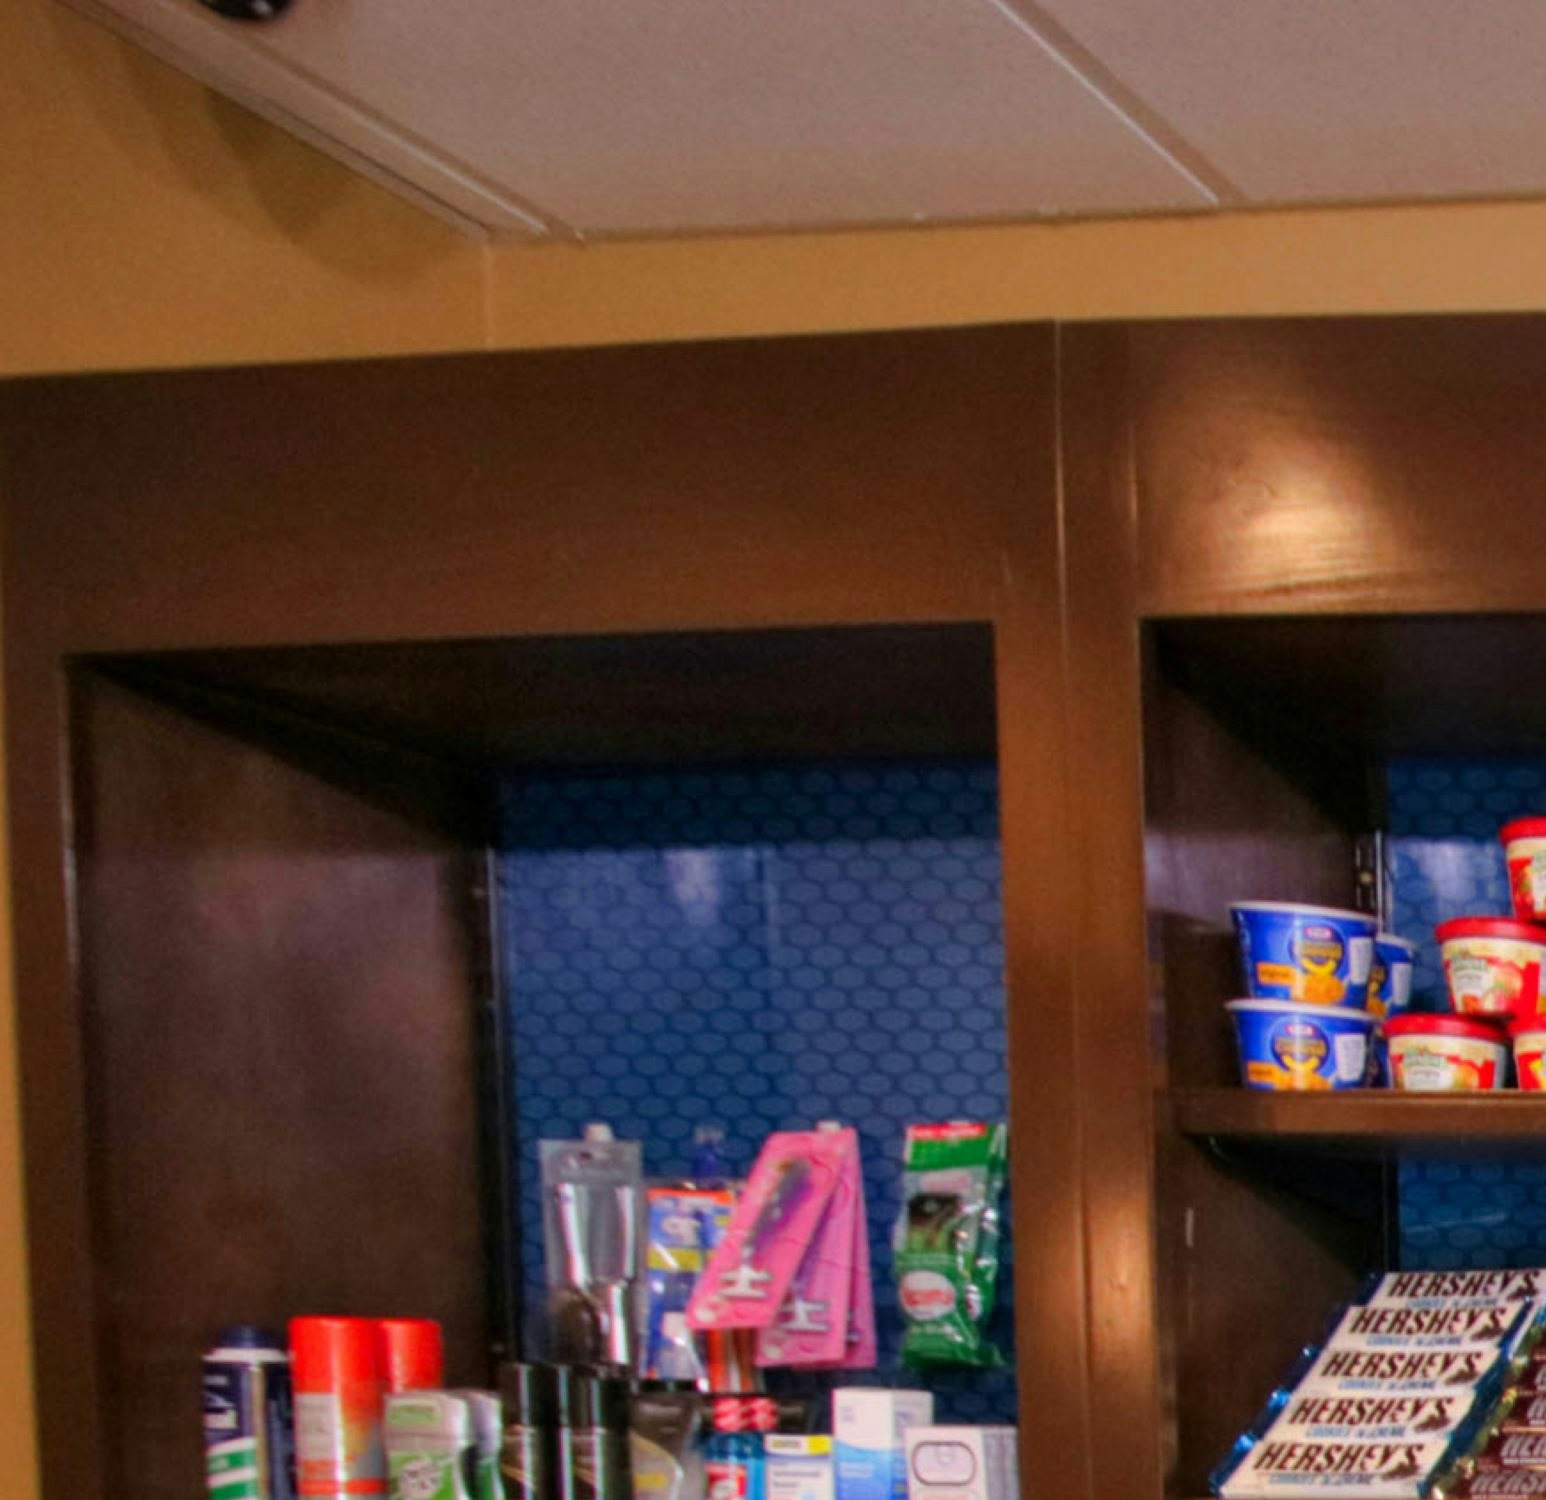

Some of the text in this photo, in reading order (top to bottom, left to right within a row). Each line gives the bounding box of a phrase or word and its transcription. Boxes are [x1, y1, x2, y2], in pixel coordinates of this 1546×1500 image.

[1388, 1271, 1541, 1299] HERSHEY'S
[1349, 1306, 1505, 1336] HERSHEY'S
[1320, 1351, 1482, 1381] HERSHEY'S
[1288, 1397, 1454, 1427] HERSHEY'S
[1253, 1443, 1423, 1473] HERSHEY'S
